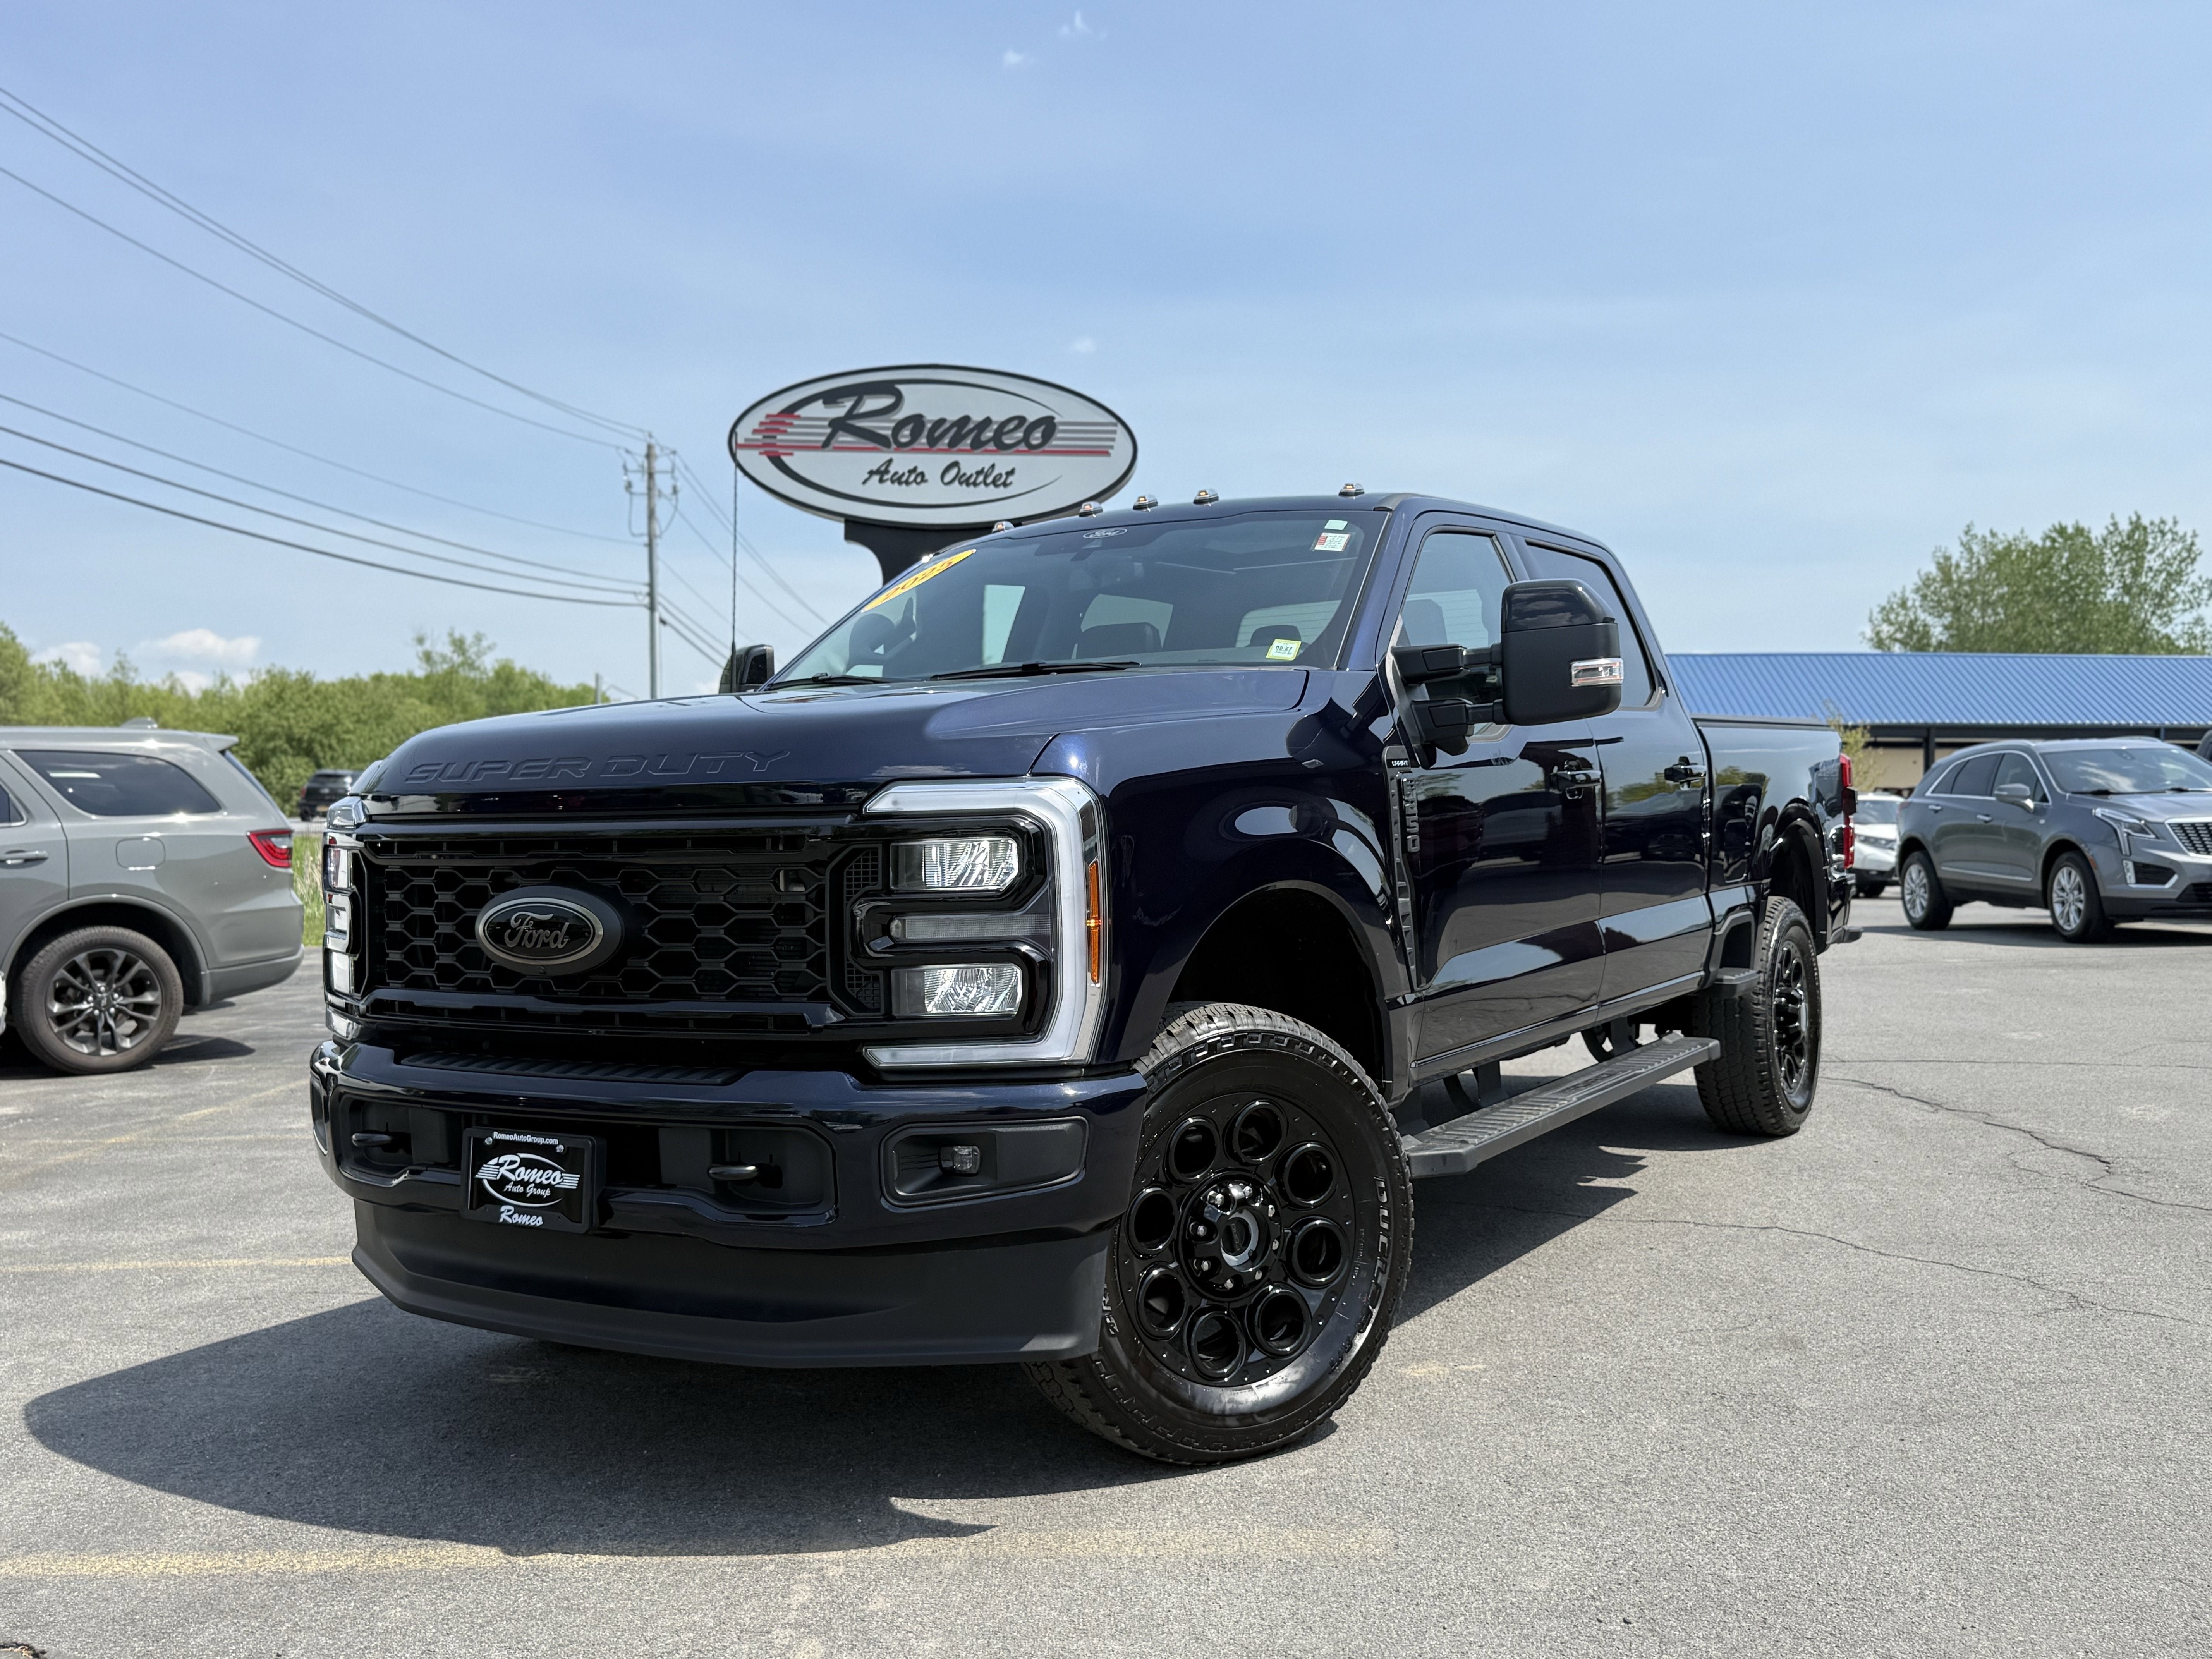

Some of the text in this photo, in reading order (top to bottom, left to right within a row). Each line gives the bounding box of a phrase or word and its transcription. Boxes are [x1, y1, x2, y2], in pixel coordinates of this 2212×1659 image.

[821, 382, 1057, 451] Romeo
[862, 457, 1015, 488] Auto Outlet
[405, 750, 790, 783] SUPER DUTY
[504, 911, 570, 949] Ford
[493, 1131, 558, 1145] RomeoAutoGroup.com
[496, 1154, 563, 1185] Romeo
[503, 1181, 551, 1198] Auto Group
[499, 1205, 543, 1226] Romeo
